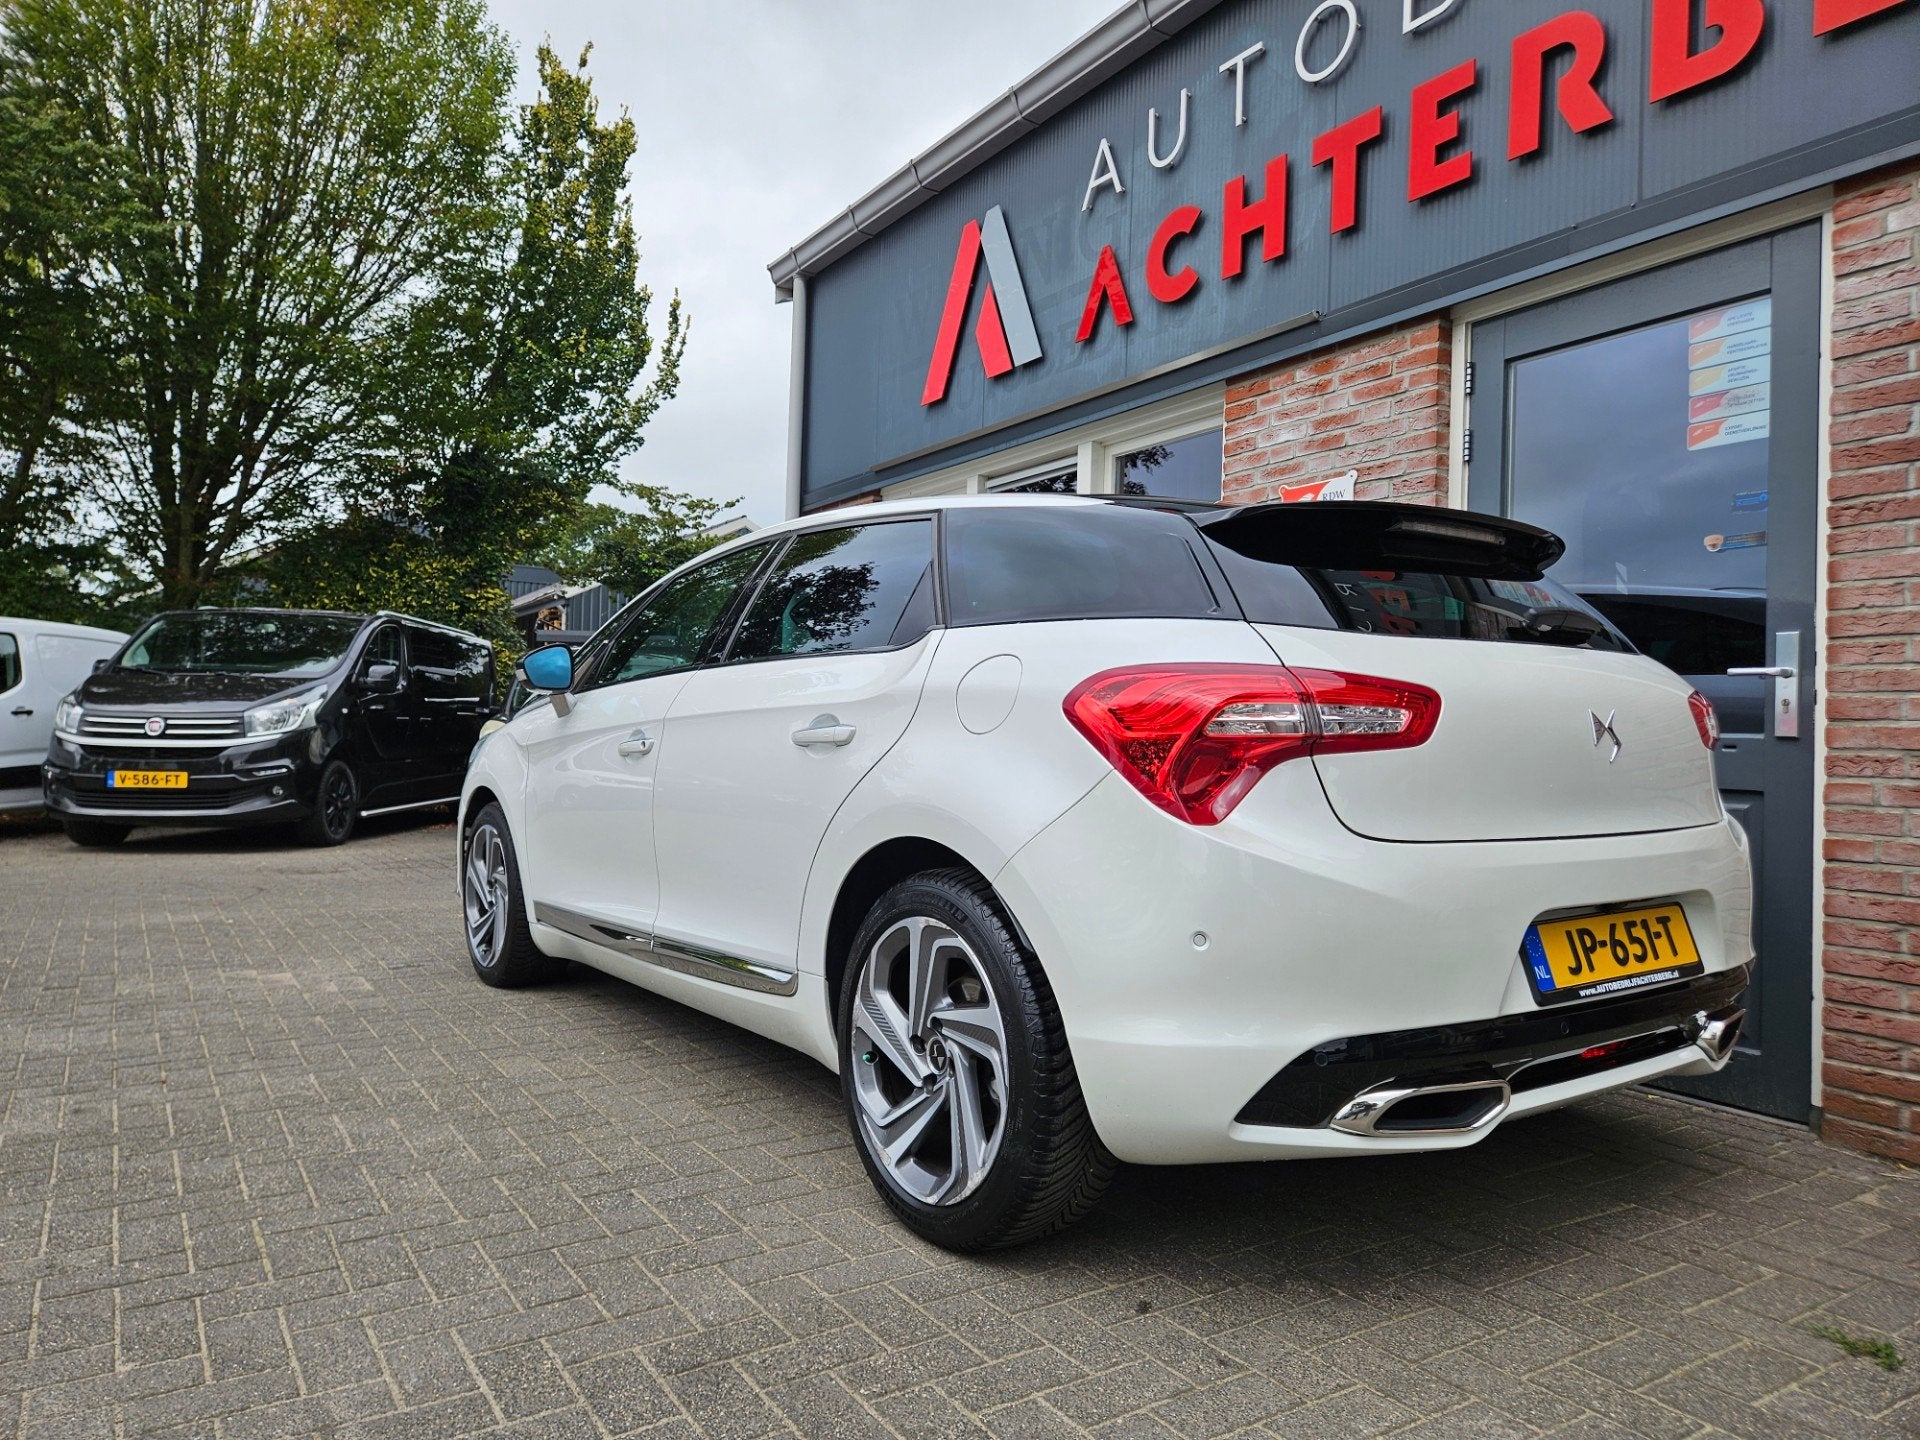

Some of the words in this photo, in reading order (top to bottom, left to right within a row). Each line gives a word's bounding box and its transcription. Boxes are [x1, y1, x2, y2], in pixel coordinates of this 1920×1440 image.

[1075, 0, 1920, 344] ACHTERB
[1322, 489, 1346, 501] RDW
[119, 774, 181, 785] V-586-FT
[1565, 916, 1679, 976] JP-651-T
[1534, 965, 1551, 980] NL
[1578, 969, 1680, 997] www.AUTOBEDRIJFACHTERBERG.nl
